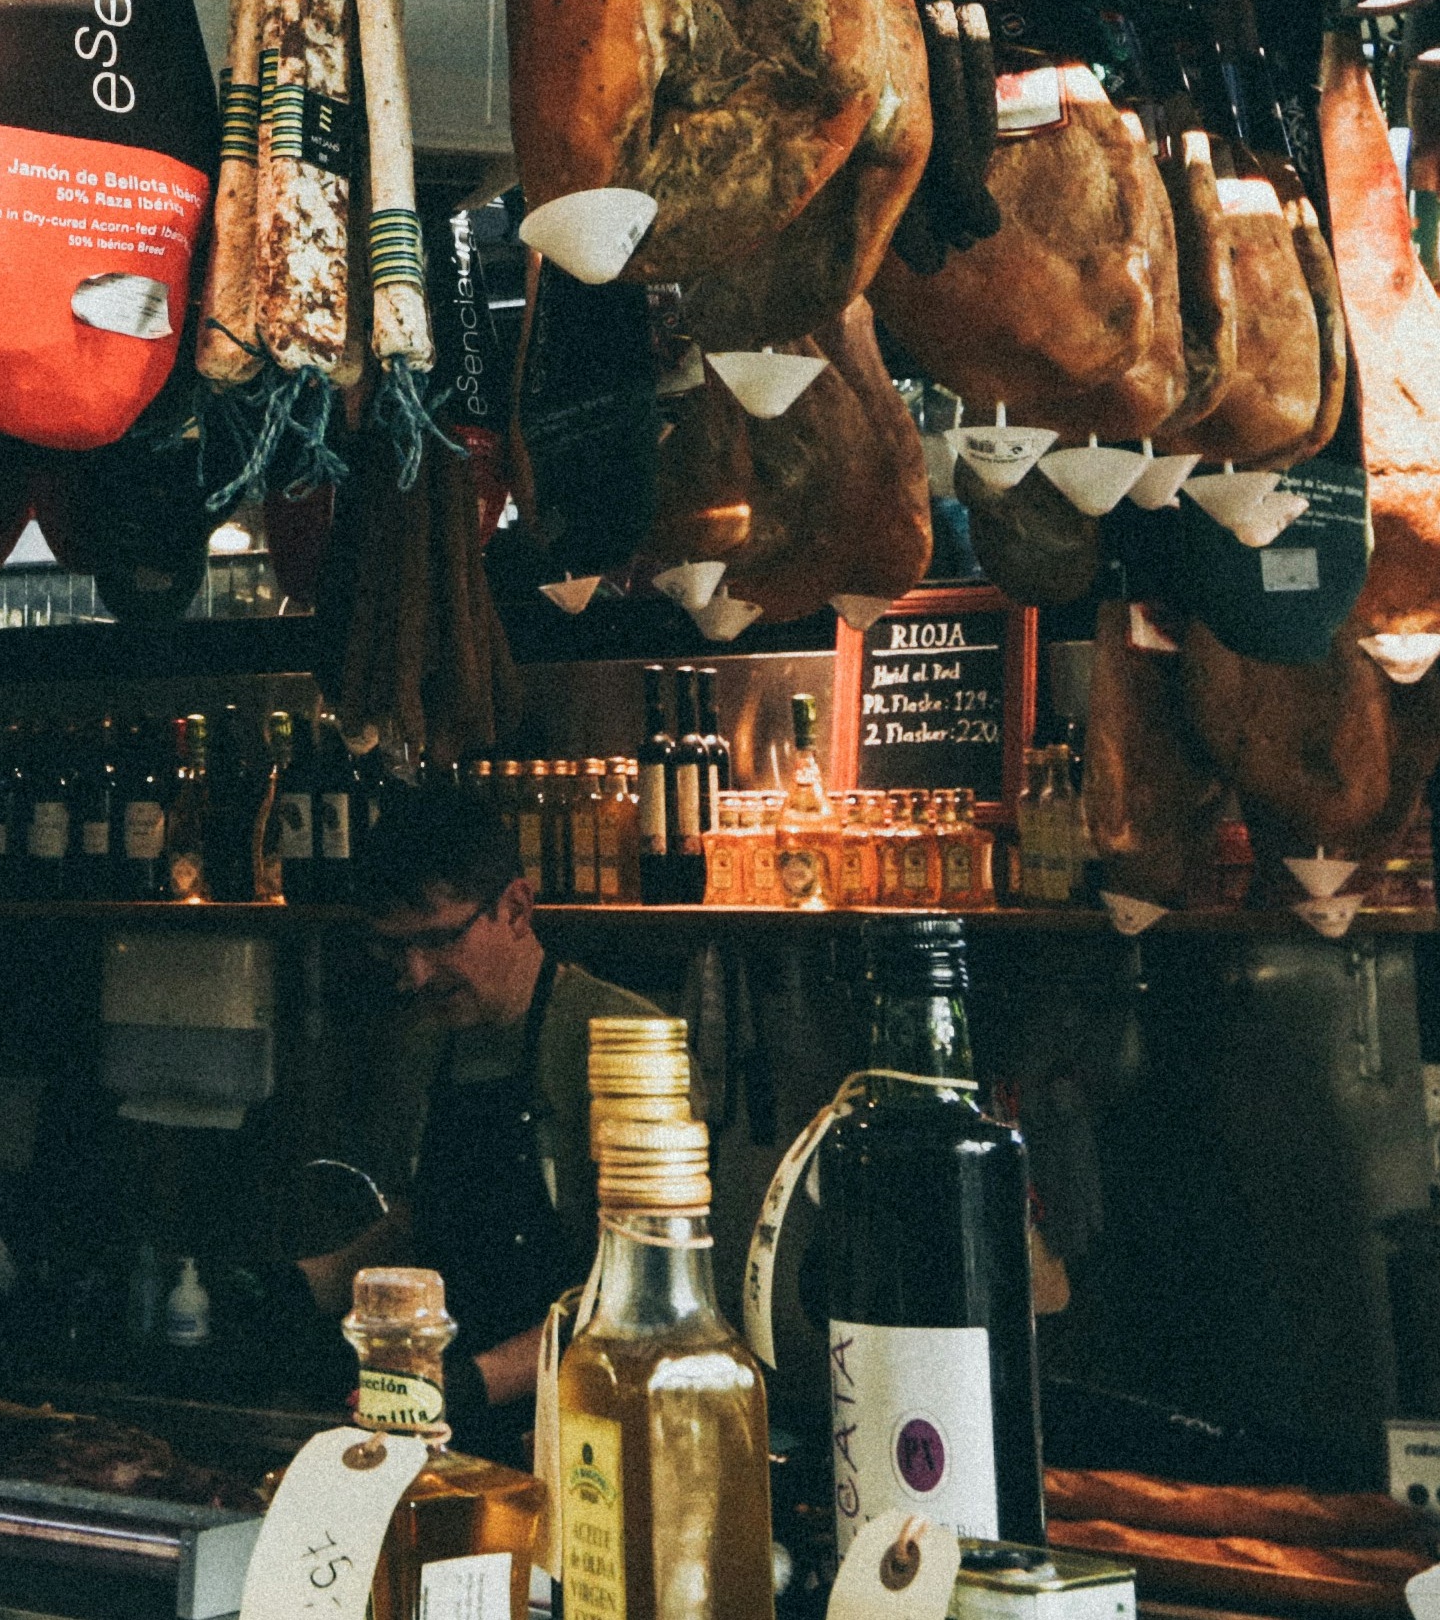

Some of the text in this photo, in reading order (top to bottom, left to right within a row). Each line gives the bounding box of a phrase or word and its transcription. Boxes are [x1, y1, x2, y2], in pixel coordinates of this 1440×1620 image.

[6, 158, 71, 183] Jamón
[76, 168, 99, 187] de
[104, 171, 169, 195] Bellota
[55, 186, 90, 205] 50%
[94, 191, 133, 211] Raza
[6, 207, 19, 222] in
[22, 210, 88, 232] Dry-cured
[90, 218, 158, 237] Acorn-fed
[67, 233, 94, 248] 50%
[96, 236, 136, 253] Ibérico
[890, 623, 967, 650] RIOJA
[864, 723, 882, 746] 2
